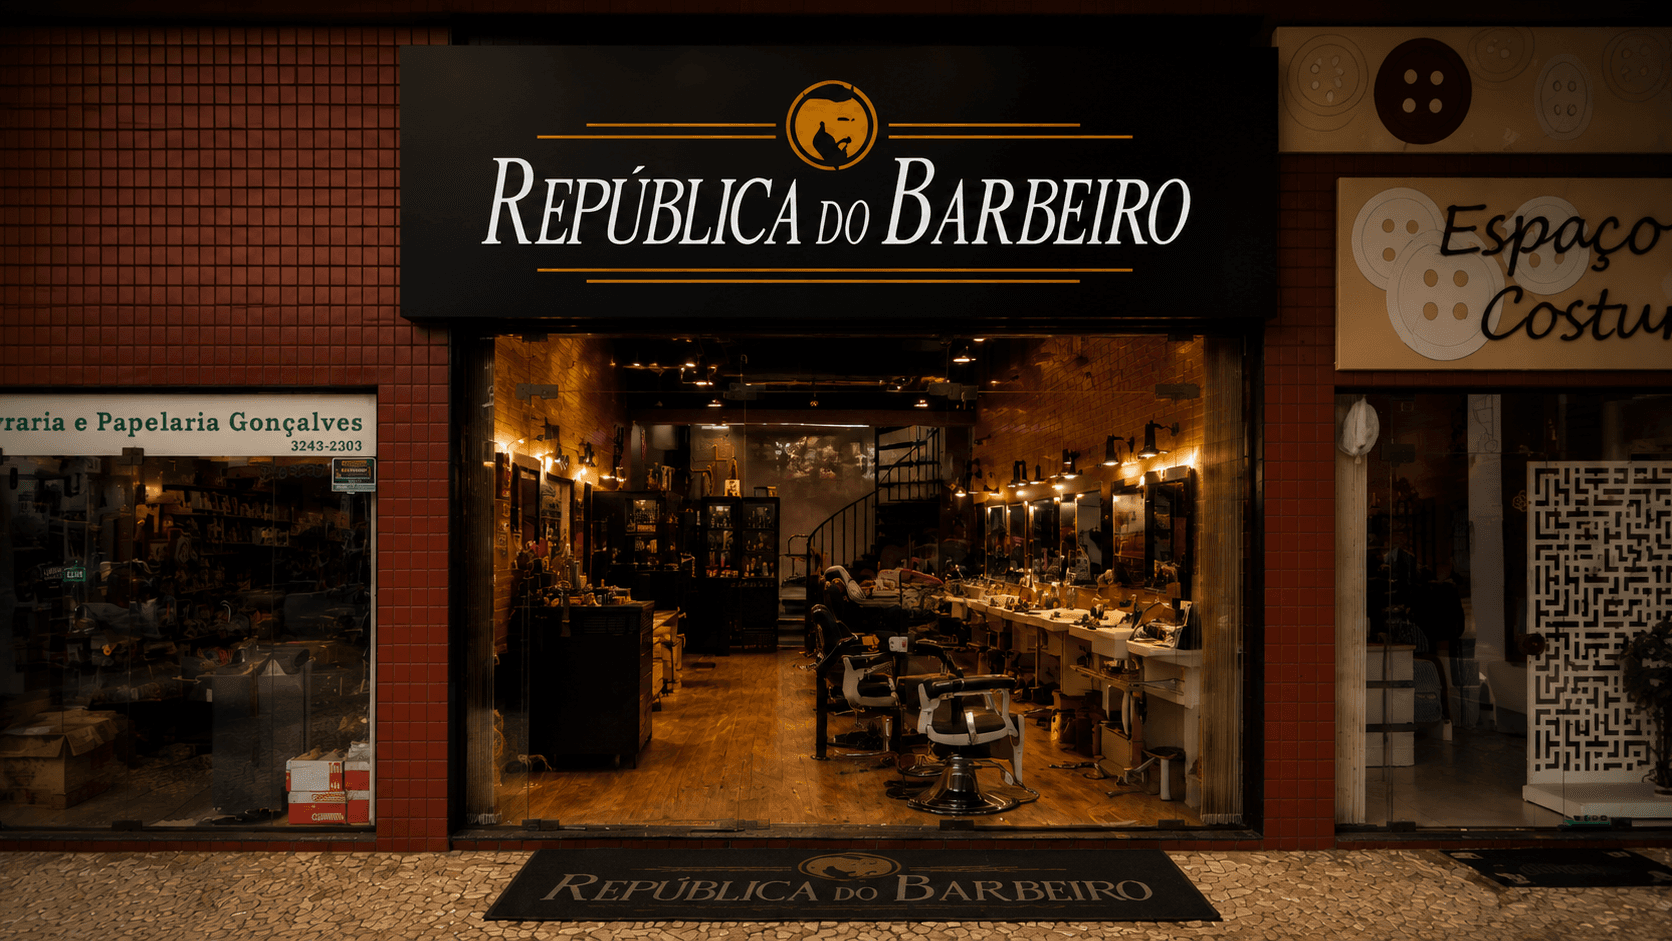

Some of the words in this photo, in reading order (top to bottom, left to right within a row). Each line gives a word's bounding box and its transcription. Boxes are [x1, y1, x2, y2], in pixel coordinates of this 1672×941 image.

[481, 157, 802, 245] REPÚBLICA
[815, 199, 870, 245] DO
[881, 157, 1191, 245] BARBEIRO
[1440, 204, 1672, 277] Espaço
[74, 417, 87, 432] e
[96, 411, 220, 438] Papelaria
[229, 411, 363, 438] Gonçalves
[291, 440, 363, 452] 3243-2303
[540, 873, 819, 901] REPÚBLICA
[894, 874, 1154, 902] BARBEIRO
